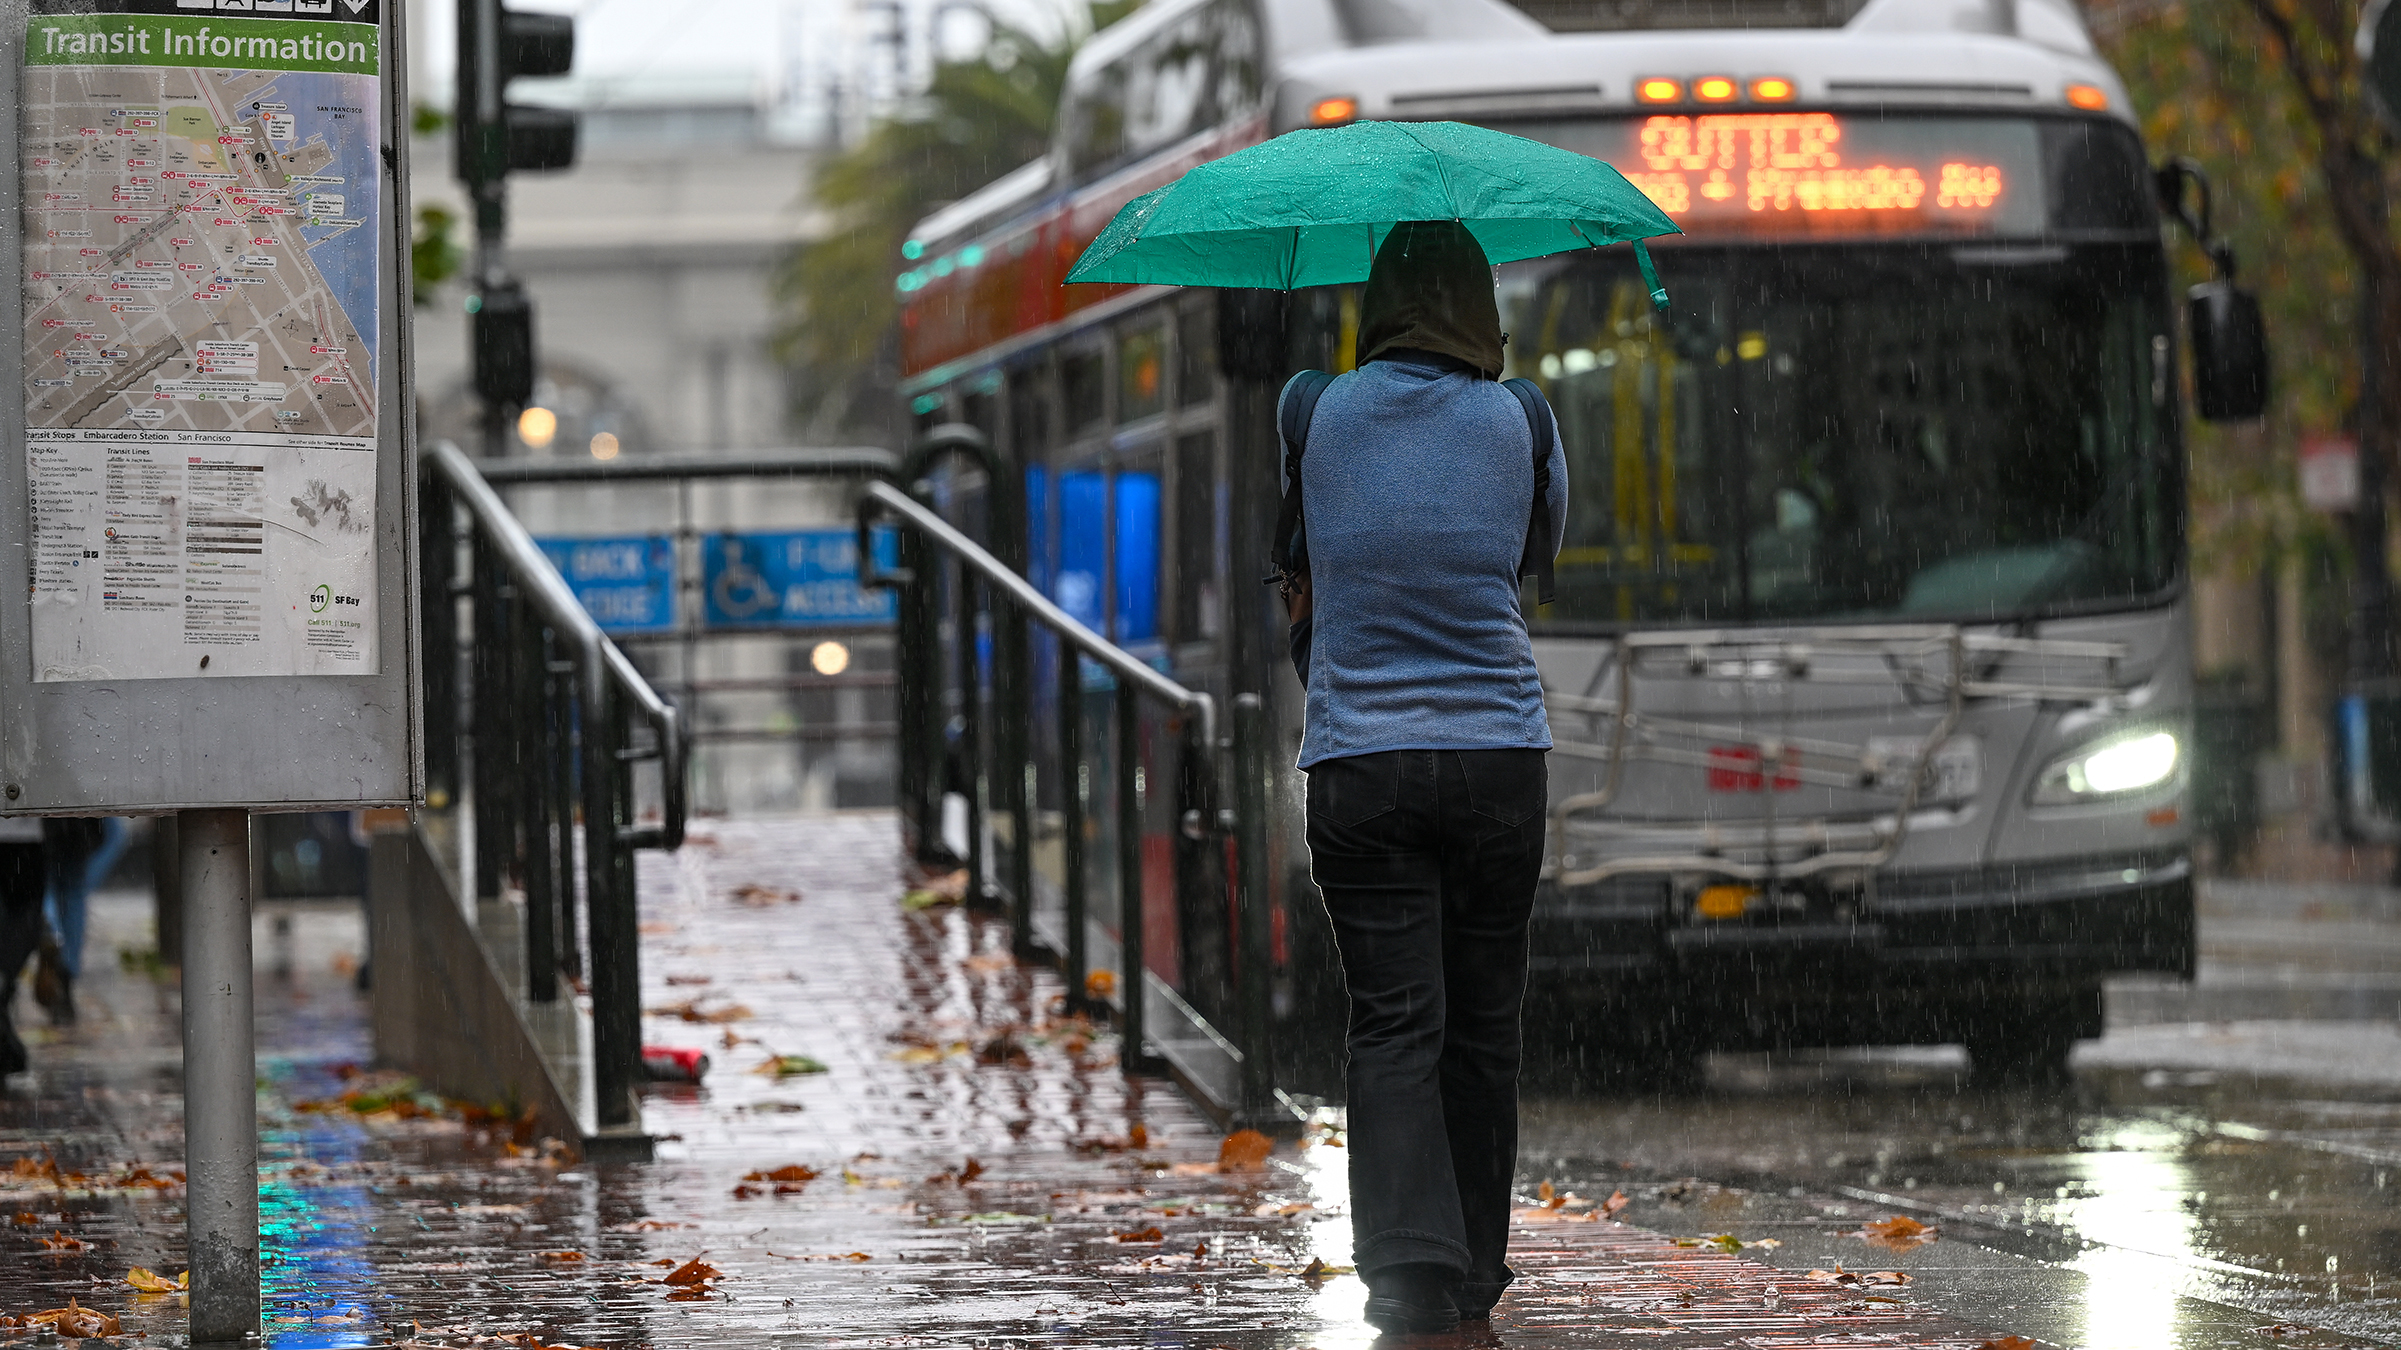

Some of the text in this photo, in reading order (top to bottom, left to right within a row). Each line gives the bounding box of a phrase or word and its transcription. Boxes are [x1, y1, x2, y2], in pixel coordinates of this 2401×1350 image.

[41, 26, 366, 64] Transit Information
[52, 431, 76, 440] Stops
[84, 431, 137, 439] Embarcadero
[140, 432, 169, 440] Station
[178, 433, 192, 441] San
[195, 434, 231, 442] Francisco
[310, 594, 324, 603] 511
[335, 596, 360, 606] SF Bay
[340, 620, 361, 629] 511.org
